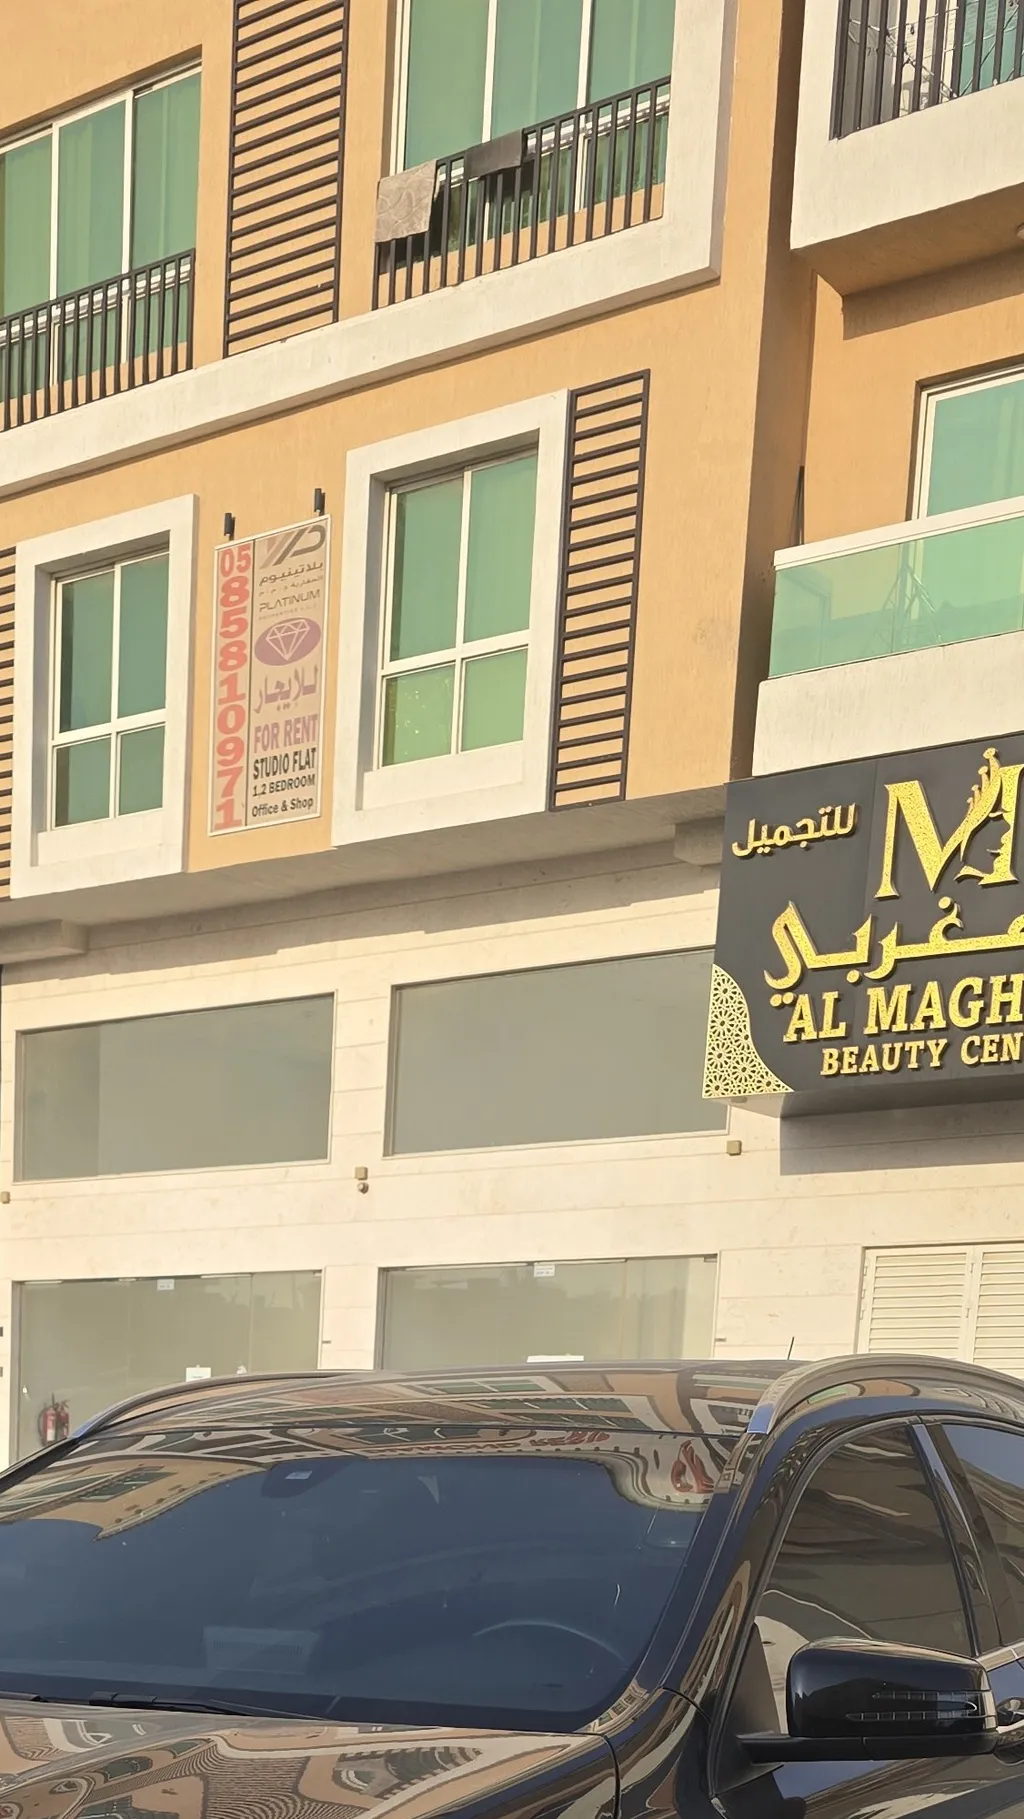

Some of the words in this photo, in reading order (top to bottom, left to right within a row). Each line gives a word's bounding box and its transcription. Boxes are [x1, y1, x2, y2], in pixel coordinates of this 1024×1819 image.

[259, 589, 321, 612] PLATINUM
[253, 722, 280, 754] FOR
[283, 714, 318, 748] RENT
[252, 753, 290, 780] STUDIO
[292, 747, 317, 773] FLAT
[269, 774, 316, 794] BEDROOM
[251, 803, 279, 818] Office
[281, 800, 288, 812] &
[290, 797, 314, 811] Shop
[731, 802, 857, 857] للتجميل
[782, 990, 847, 1043] AL
[862, 973, 1024, 1036] MAGH
[820, 1038, 948, 1078] BEAUTY
[960, 1031, 1024, 1066] CEN
